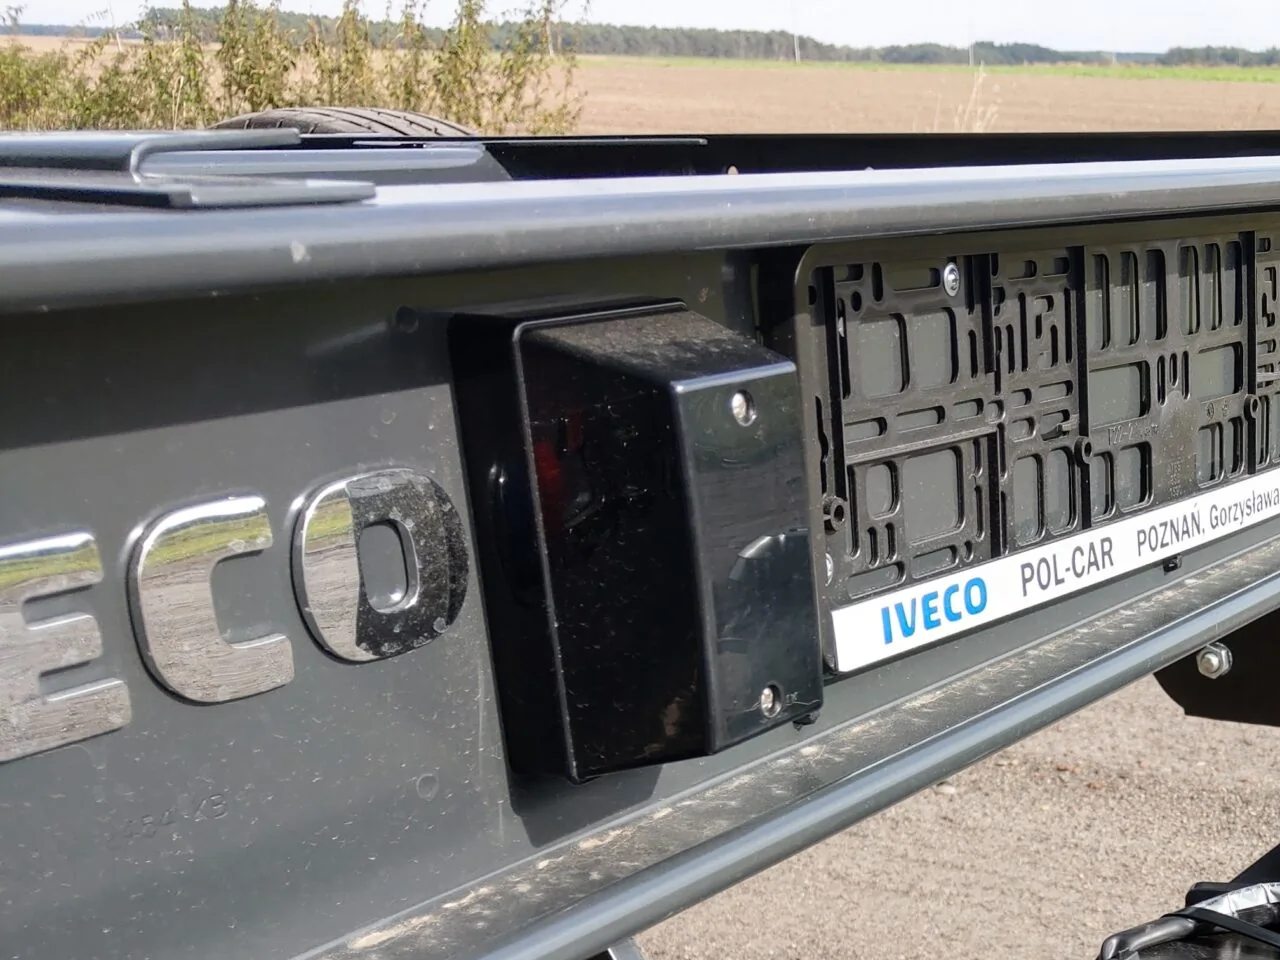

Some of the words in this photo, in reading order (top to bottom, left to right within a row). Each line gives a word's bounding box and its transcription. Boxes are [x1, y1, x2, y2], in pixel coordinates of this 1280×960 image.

[881, 577, 987, 645] IVECO
[1020, 536, 1114, 597] POL-CAR
[1210, 488, 1280, 530] Gorzysława
